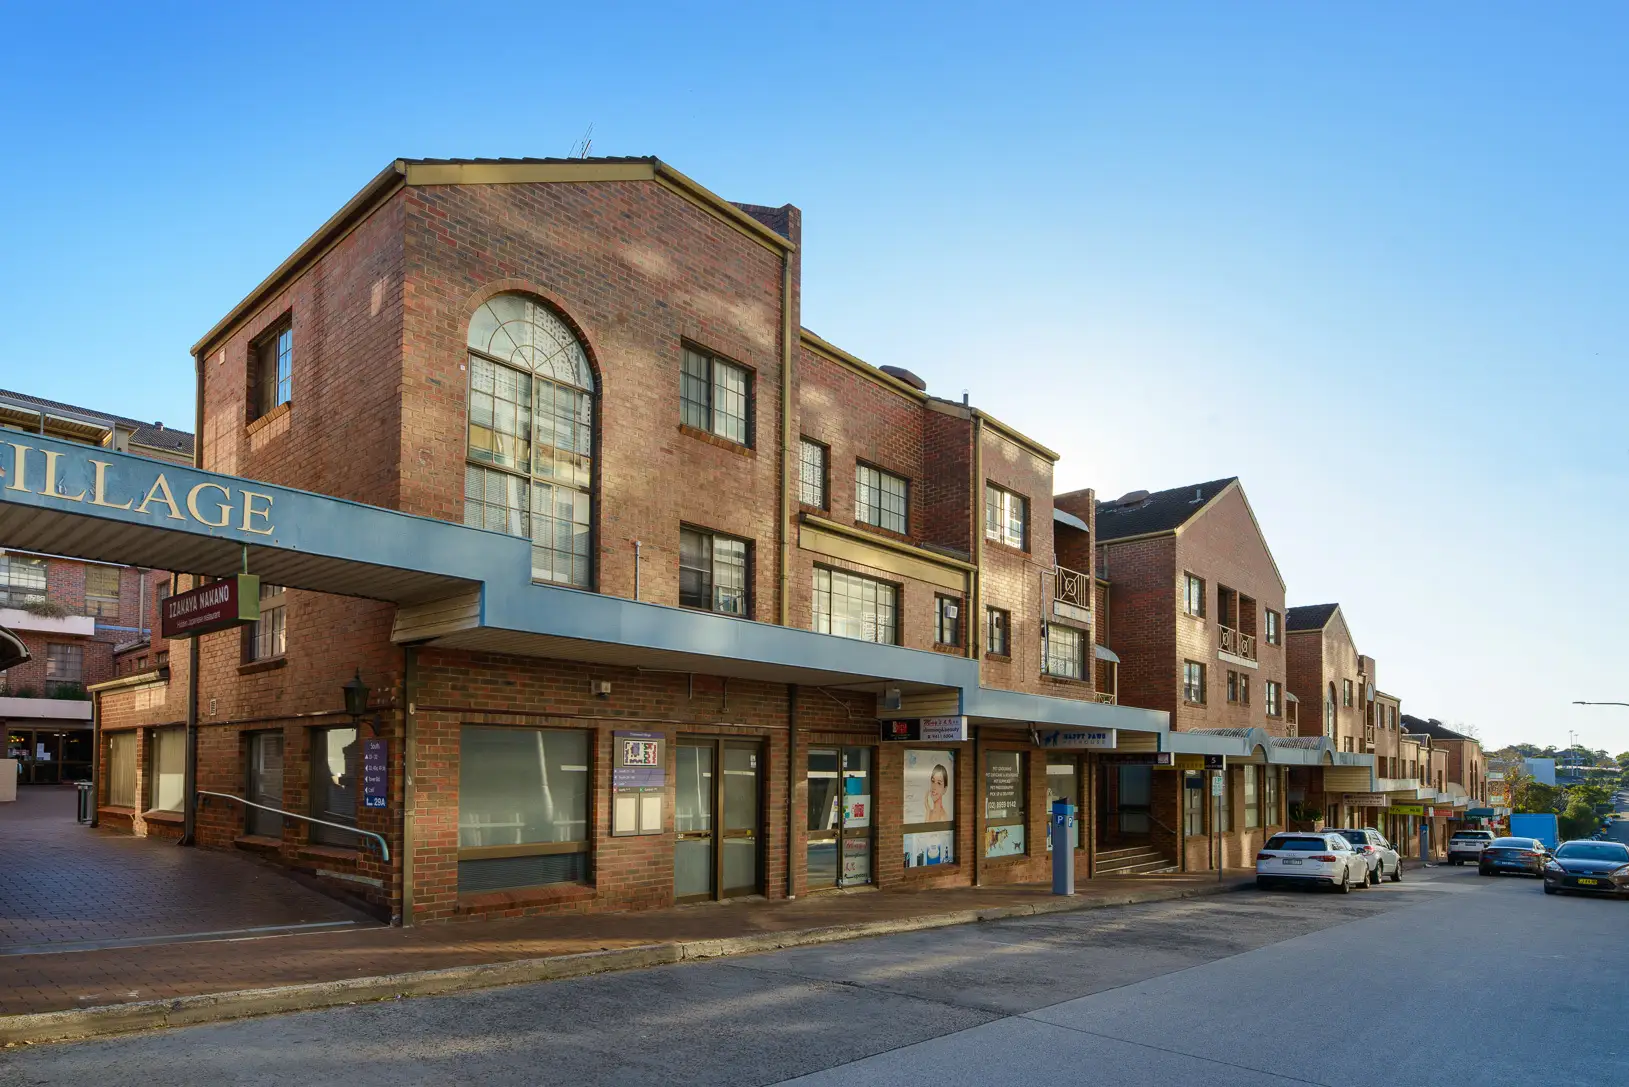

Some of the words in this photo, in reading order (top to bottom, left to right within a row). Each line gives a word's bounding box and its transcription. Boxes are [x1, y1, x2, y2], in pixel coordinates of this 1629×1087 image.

[0, 439, 276, 536] ILLAGE
[169, 595, 198, 618] IZAKAYA
[199, 584, 230, 609] NAKANO
